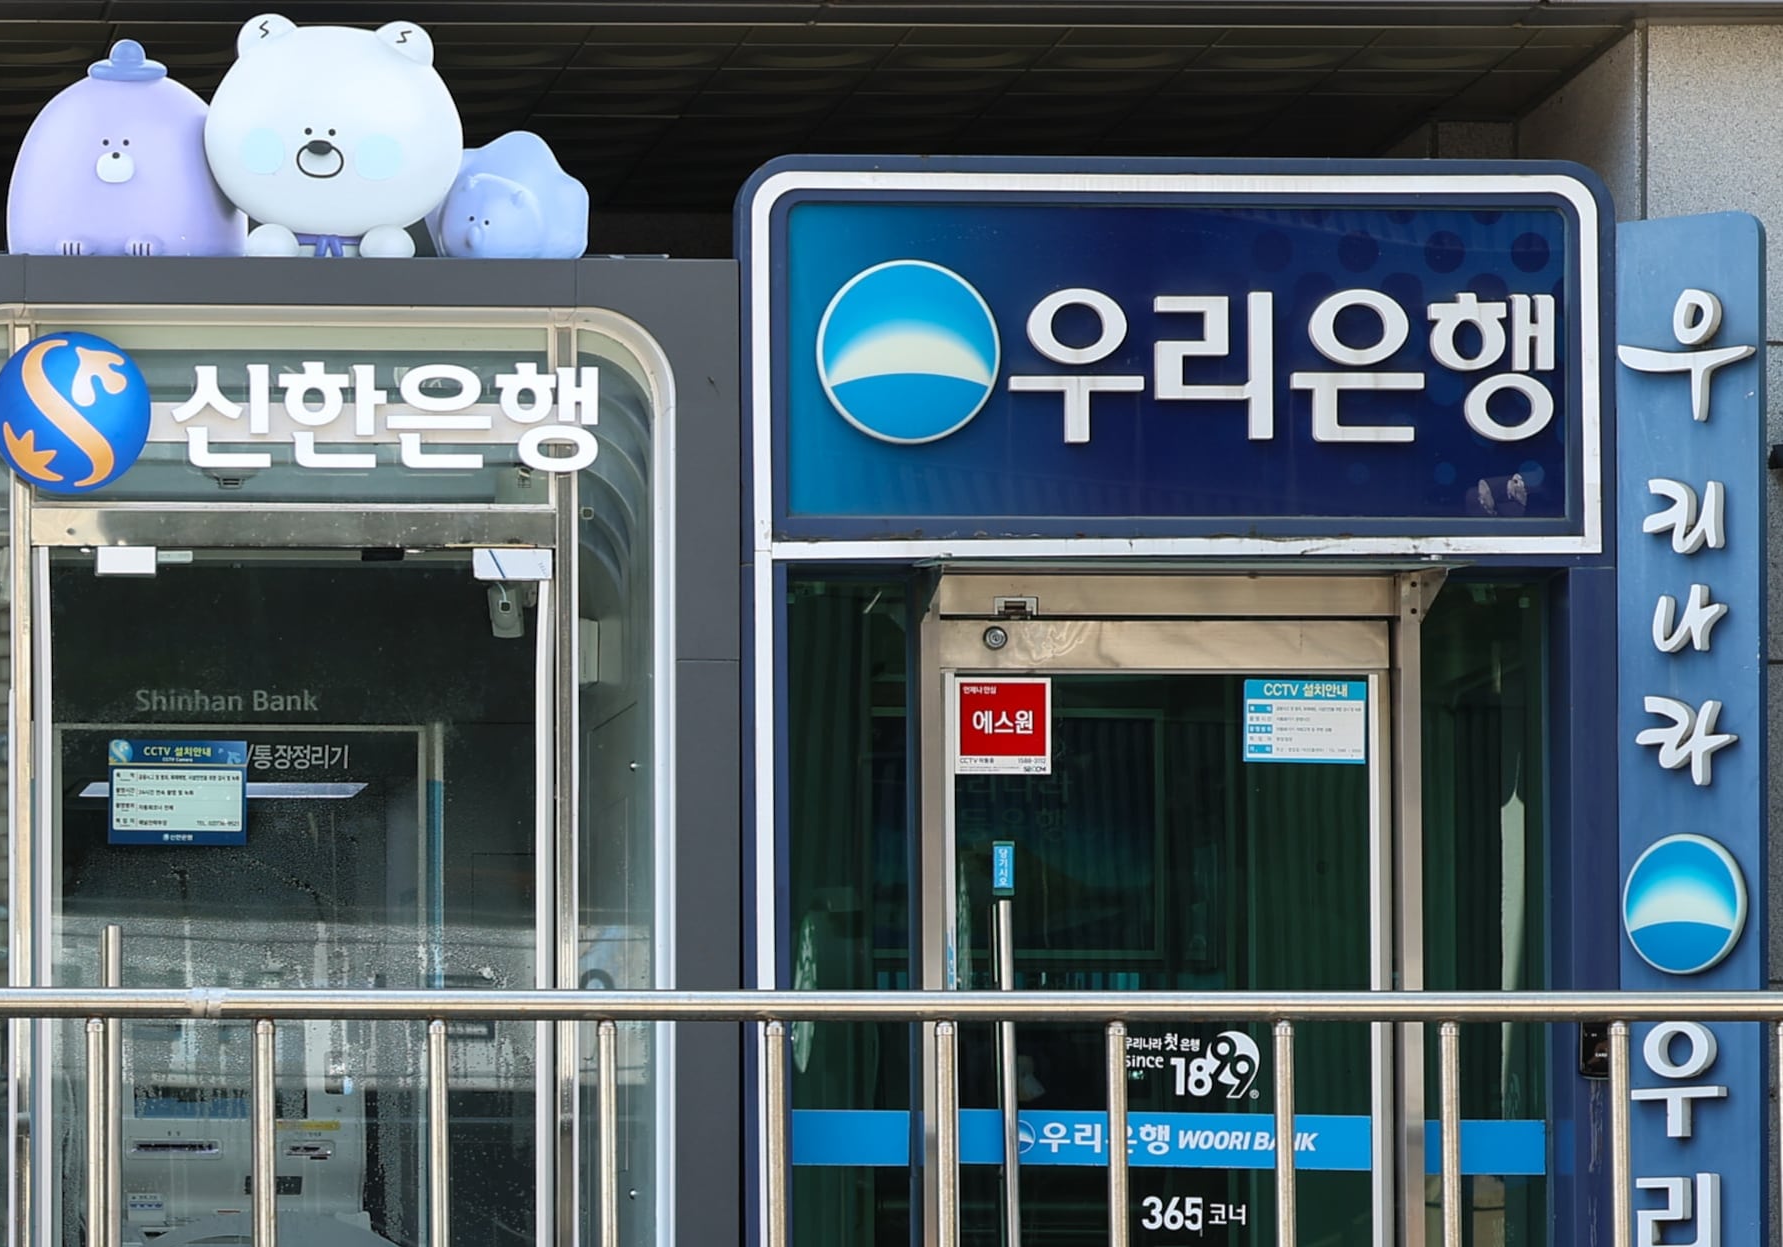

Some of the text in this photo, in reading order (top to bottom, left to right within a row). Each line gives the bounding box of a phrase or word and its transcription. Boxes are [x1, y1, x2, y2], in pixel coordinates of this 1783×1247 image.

[1007, 287, 1557, 444] 우리은행
[171, 360, 601, 474] 신한은행
[1617, 288, 1757, 787] 우리나라
[134, 688, 319, 713] Shinhan Bank
[1263, 682, 1349, 698] CCTV 설치안내
[972, 709, 1034, 735] 에스원
[143, 745, 212, 758] CCTV 설치안내
[1125, 1032, 1201, 1052] 우리나라 첫 은행
[1125, 1054, 1165, 1069] since
[1178, 1129, 1251, 1151] WOORI
[1141, 1195, 1247, 1232] 365 코너
